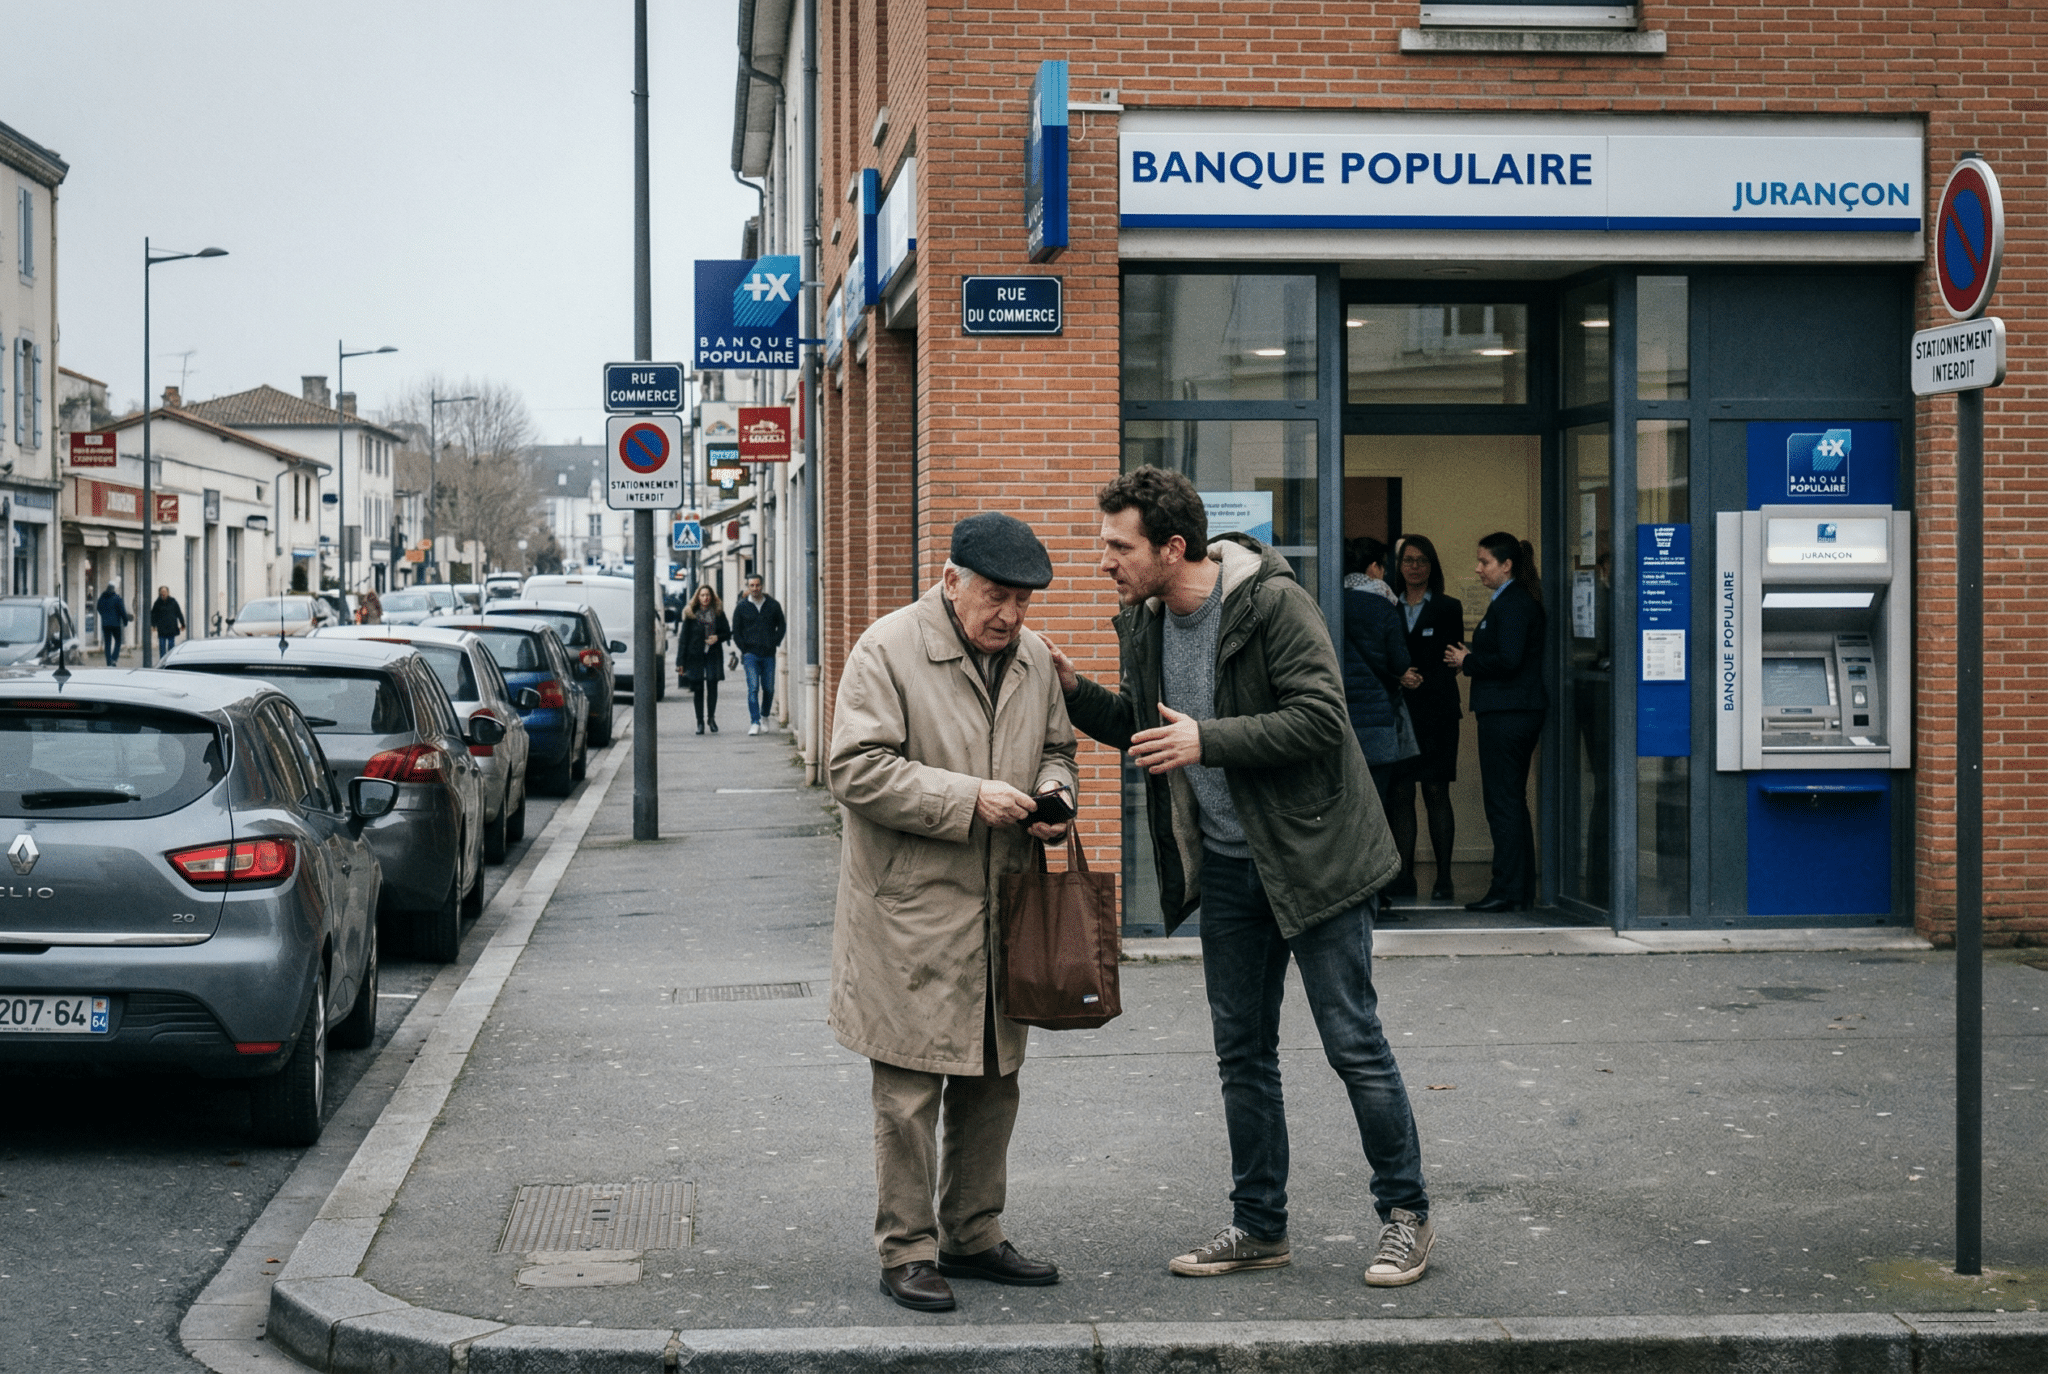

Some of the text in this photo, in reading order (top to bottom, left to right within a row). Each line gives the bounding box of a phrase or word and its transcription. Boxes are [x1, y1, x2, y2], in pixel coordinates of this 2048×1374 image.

[1132, 150, 1592, 190] BANQUE POPULAIRE
[1732, 182, 1910, 212] JURANÇON
[997, 287, 1027, 301] RUE
[967, 309, 1056, 322] DU COMMERCE
[699, 336, 794, 349] BANQUE
[1915, 328, 1993, 361] STATIONNEMENT
[699, 351, 794, 364] POPULAIRE
[1931, 358, 1975, 383] INTERDIT
[631, 373, 656, 385] RUE
[610, 390, 678, 403] COMMERCE
[610, 480, 679, 490] STATIONNEMENT
[1789, 475, 1846, 484] BANQUE
[1789, 484, 1846, 493] POPULAIRE
[626, 493, 665, 502] INTERDIT
[1801, 552, 1853, 561] JURANÇON
[1723, 571, 1737, 711] BANQUE POPULAIRE
[92, 1015, 107, 1028] 64
